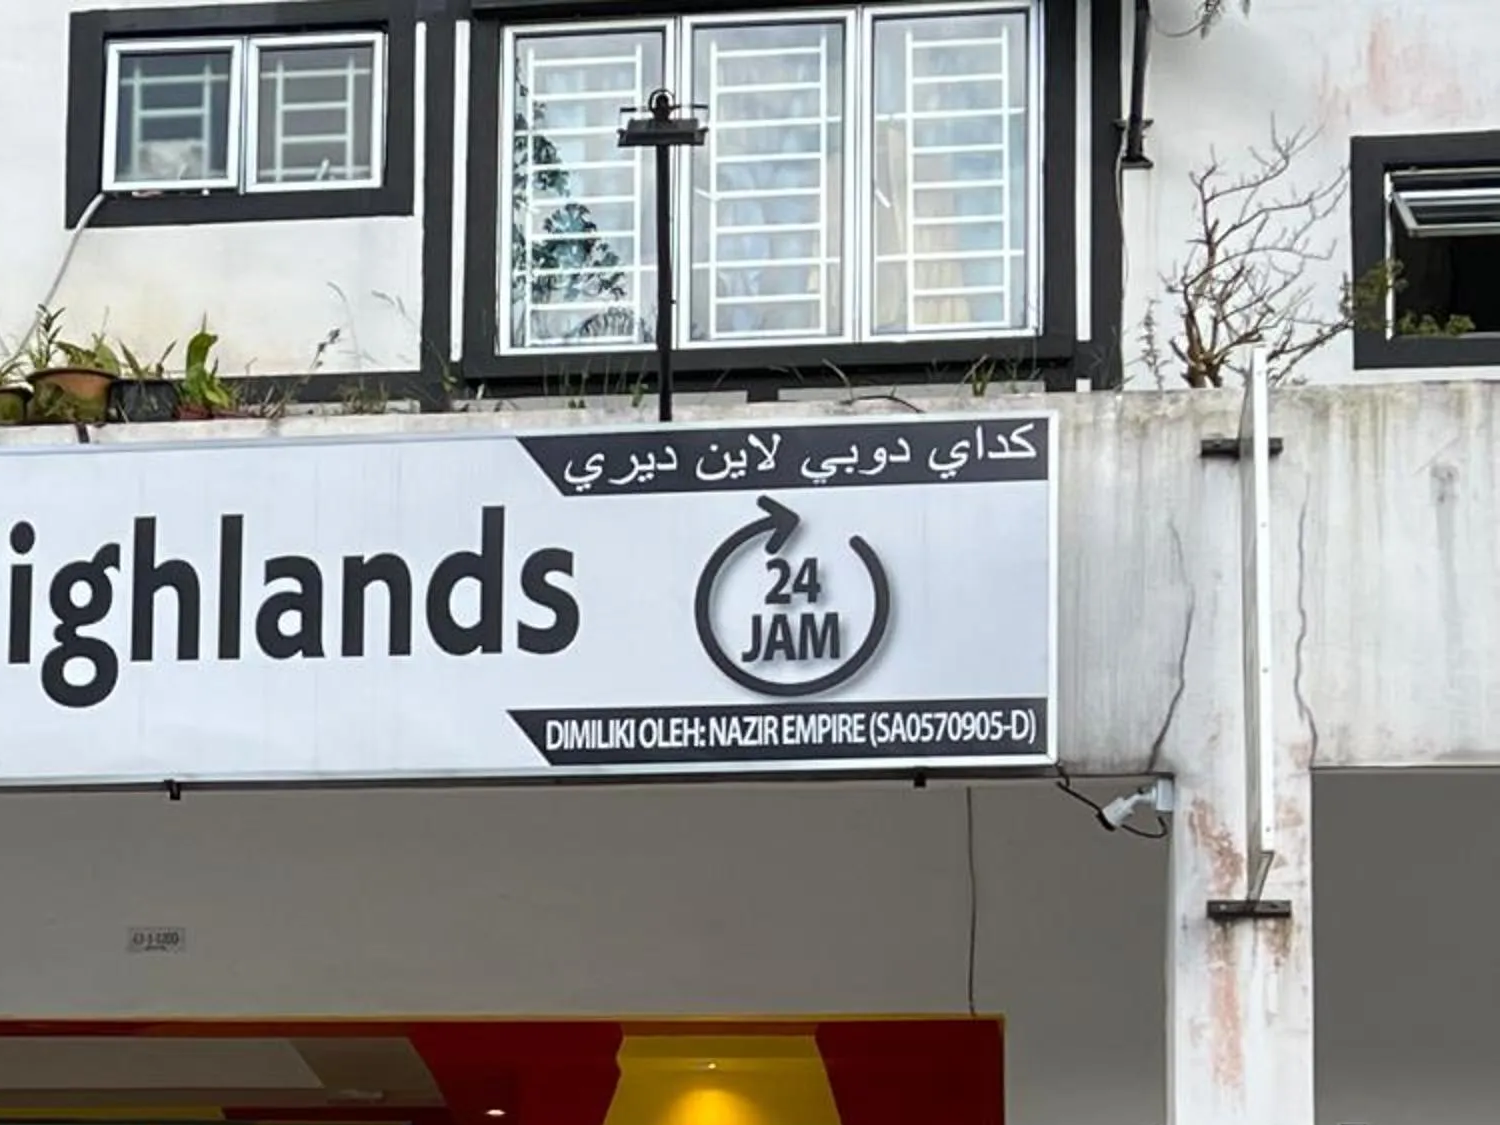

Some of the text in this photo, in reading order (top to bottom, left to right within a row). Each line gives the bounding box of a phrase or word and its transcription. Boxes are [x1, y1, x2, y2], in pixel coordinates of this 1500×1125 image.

[563, 424, 1037, 491] كداي دوبي لاين ديري
[765, 558, 821, 604] 24
[741, 612, 840, 662] JAM
[546, 710, 1037, 751] DIMILIKI OLEH: NAZIR EMPIRE (SA0570905-D)
